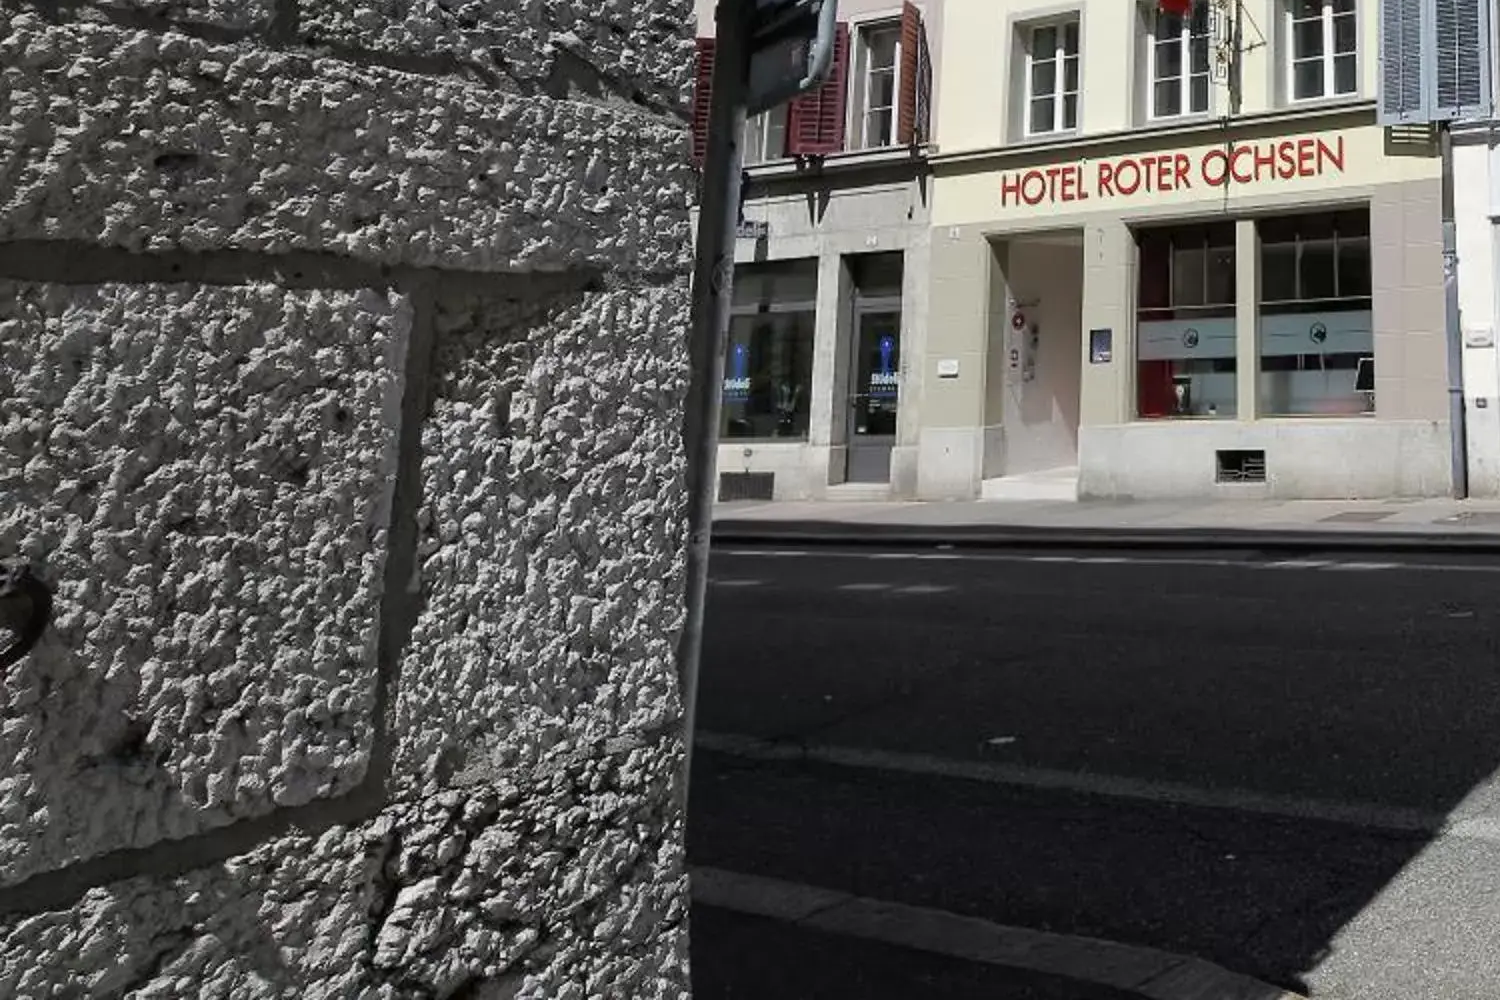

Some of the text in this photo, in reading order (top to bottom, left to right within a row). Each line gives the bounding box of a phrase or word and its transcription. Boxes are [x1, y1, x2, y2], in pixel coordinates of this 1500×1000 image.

[1001, 137, 1345, 207] HOTEL ROTER OCHSEN
